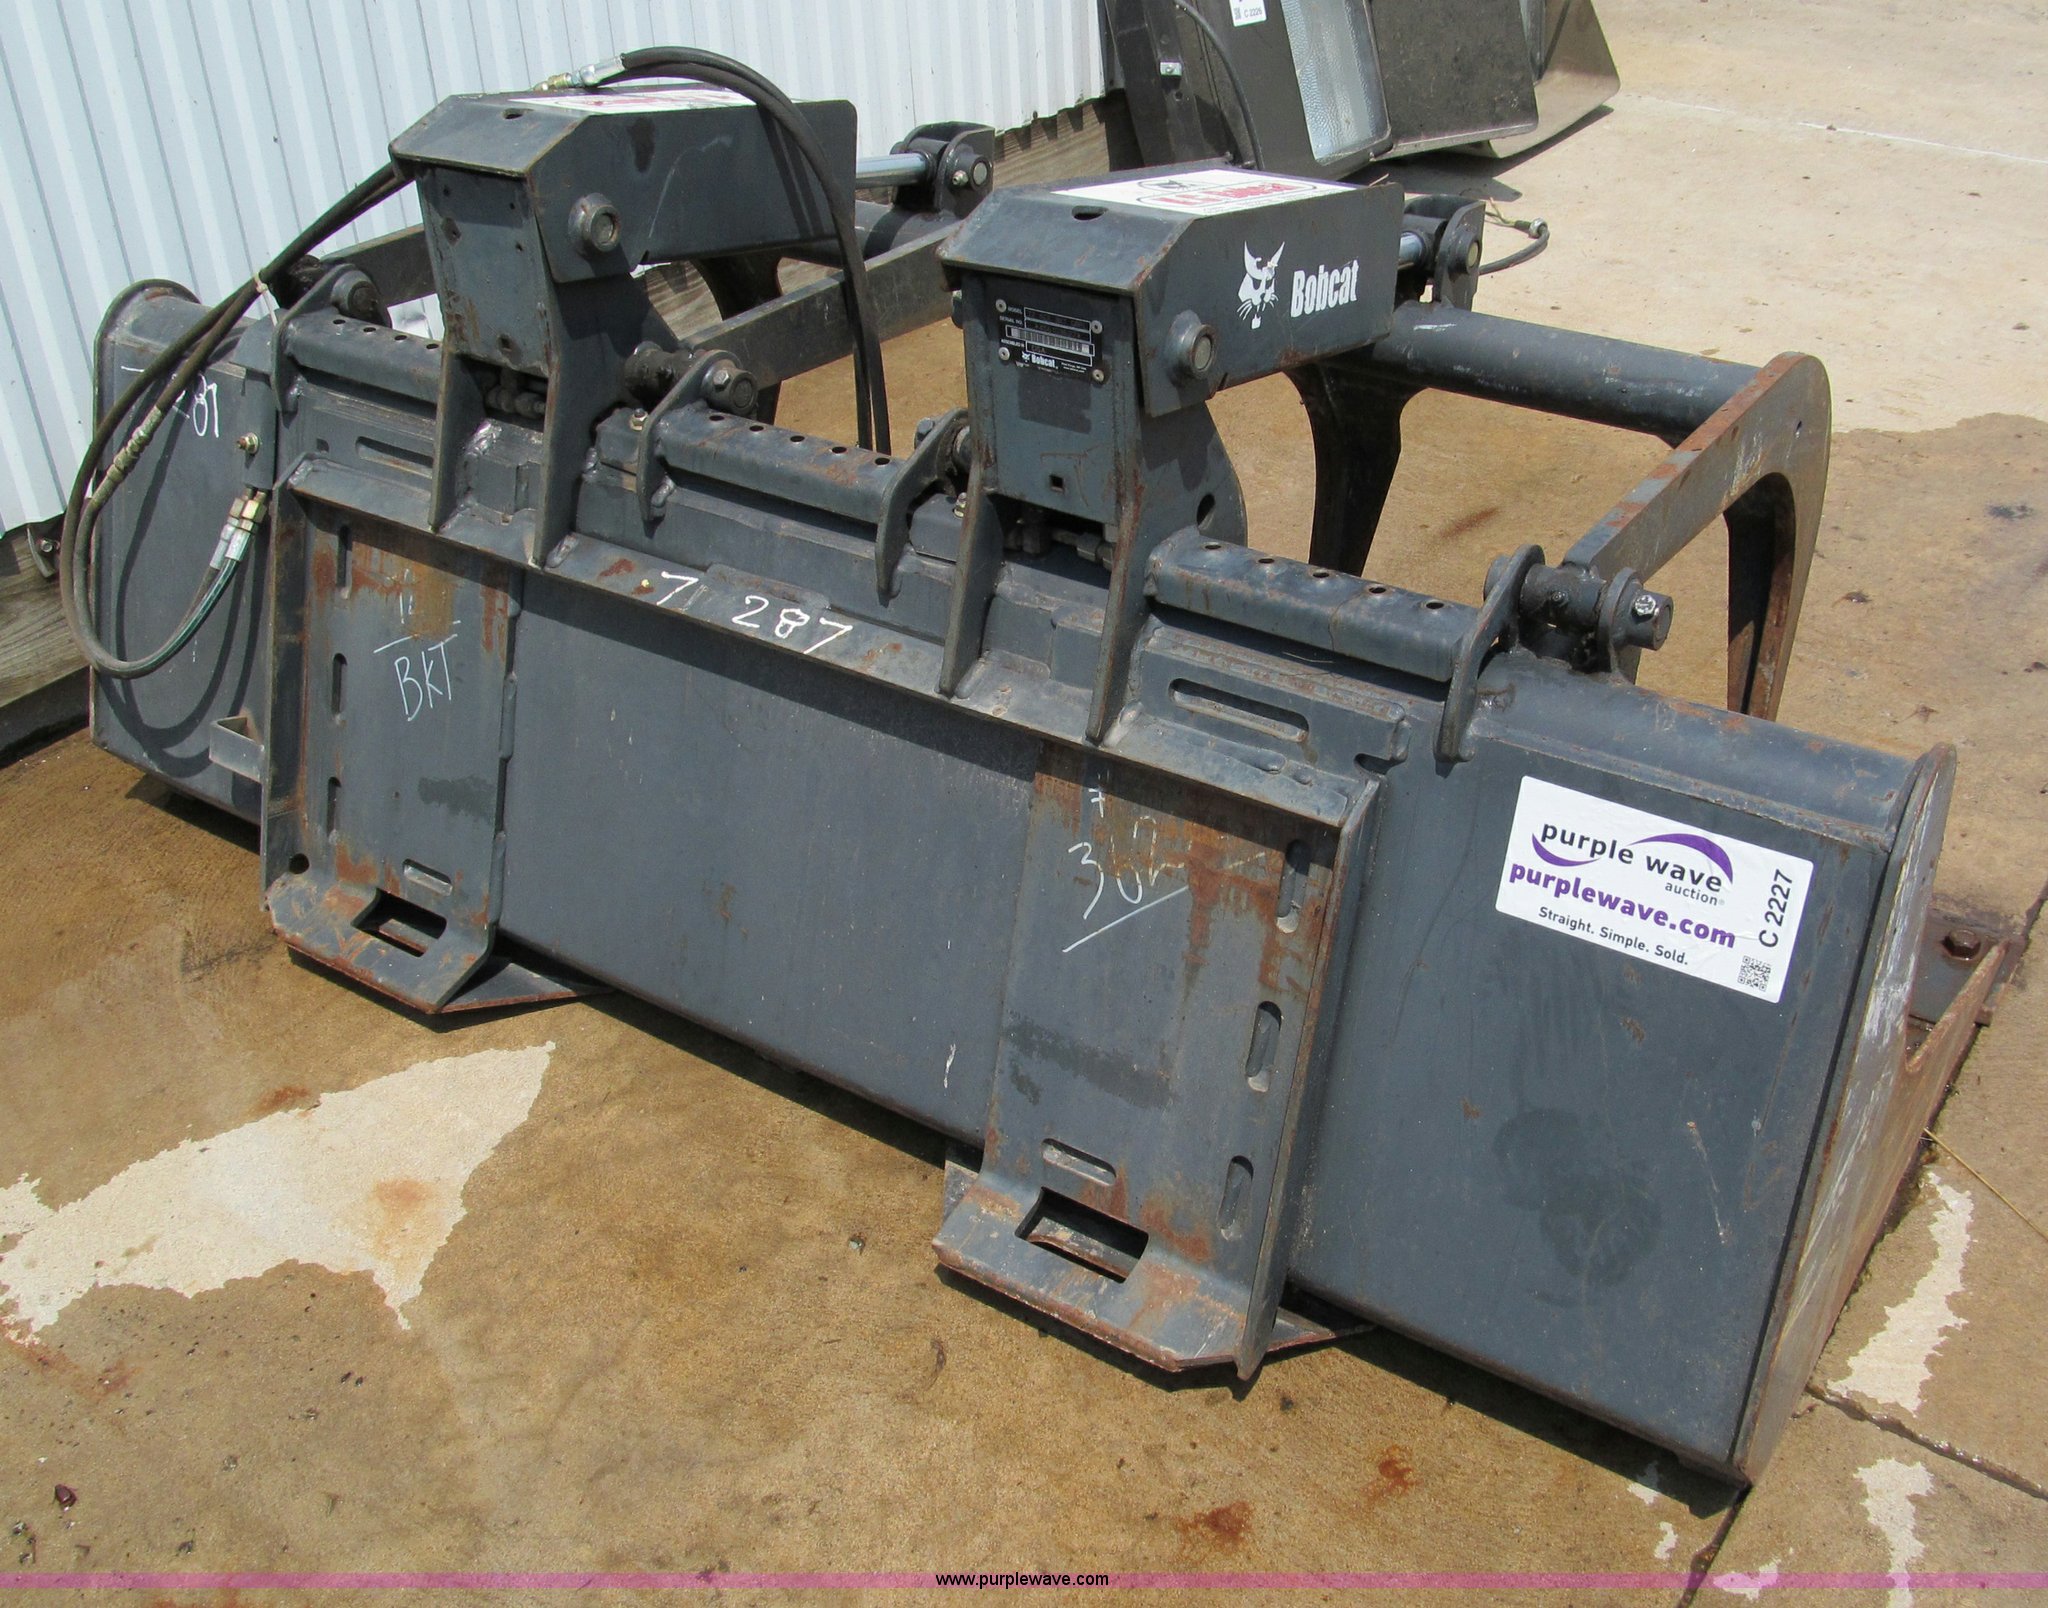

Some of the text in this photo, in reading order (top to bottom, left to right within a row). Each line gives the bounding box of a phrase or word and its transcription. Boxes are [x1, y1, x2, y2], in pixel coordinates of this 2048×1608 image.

[1290, 259, 1359, 318] Bobcat
[1031, 353, 1056, 368] Bobcat
[1541, 823, 1722, 893] purple wave
[1509, 863, 1736, 949] purplewave.com
[1539, 906, 1689, 966] Straight. Simple. Sold.
[1758, 869, 1793, 949] C 2227
